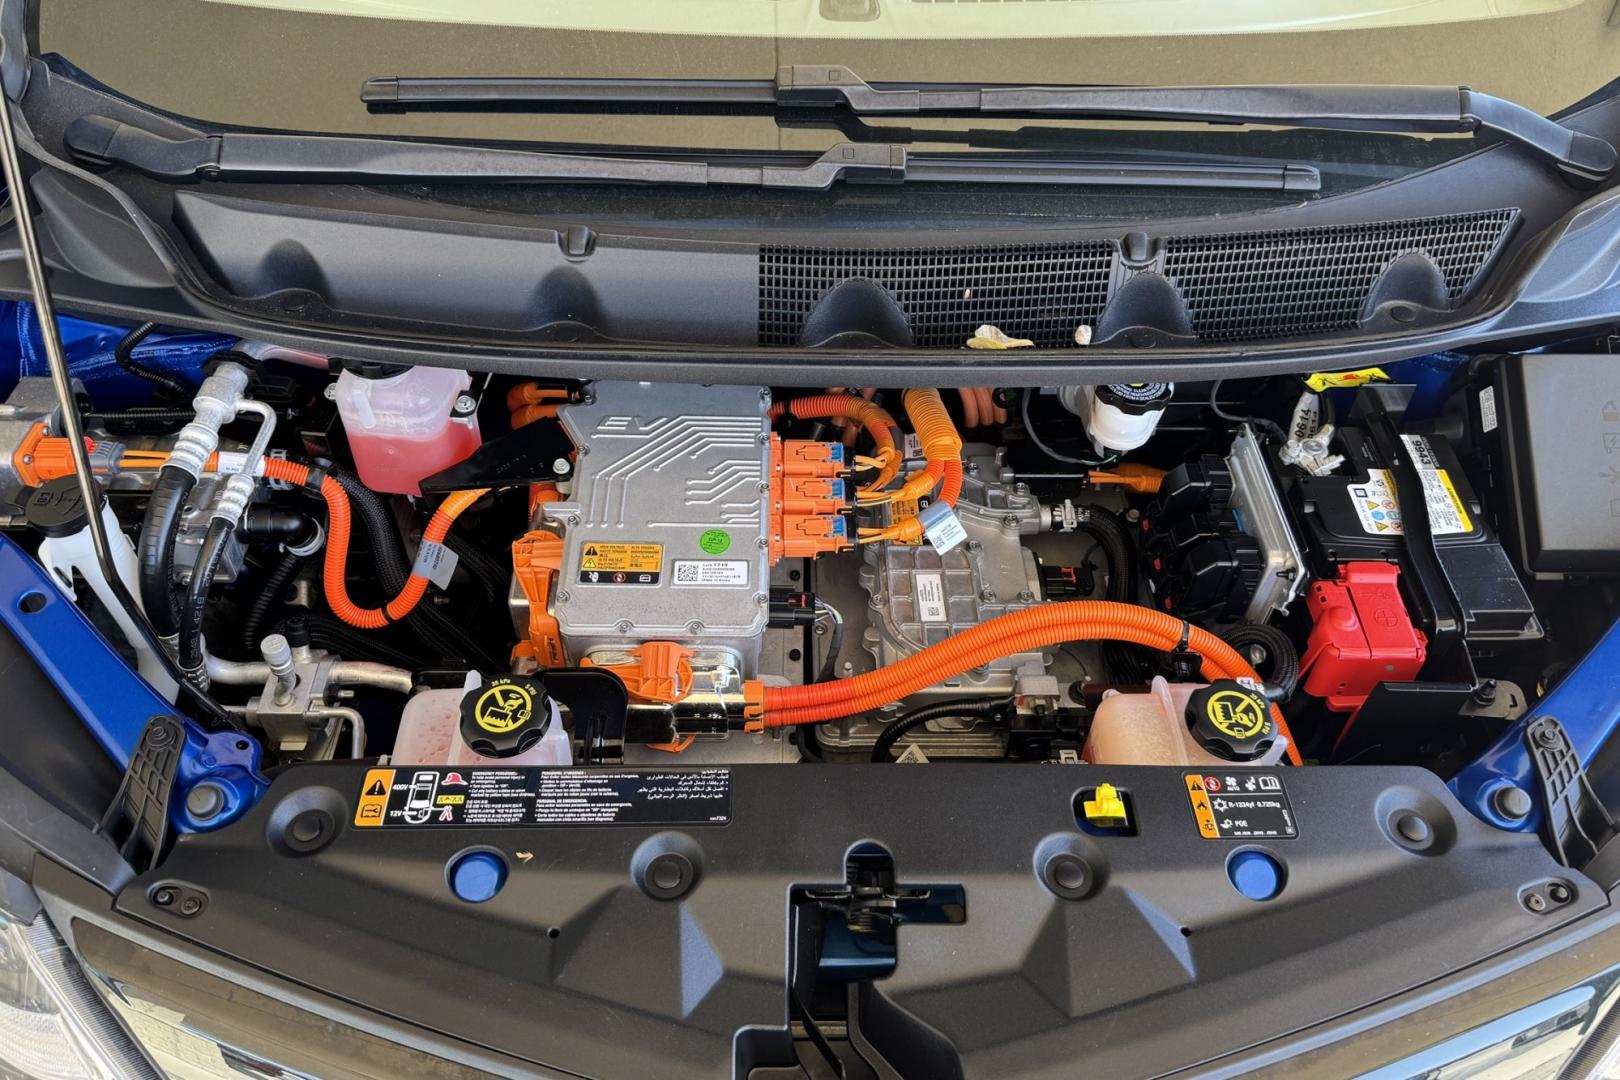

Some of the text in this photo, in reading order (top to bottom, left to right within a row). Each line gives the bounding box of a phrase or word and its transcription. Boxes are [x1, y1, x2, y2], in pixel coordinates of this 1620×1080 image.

[597, 416, 668, 430] EV
[1295, 409, 1311, 438] 0614
[1412, 439, 1431, 465] 9943
